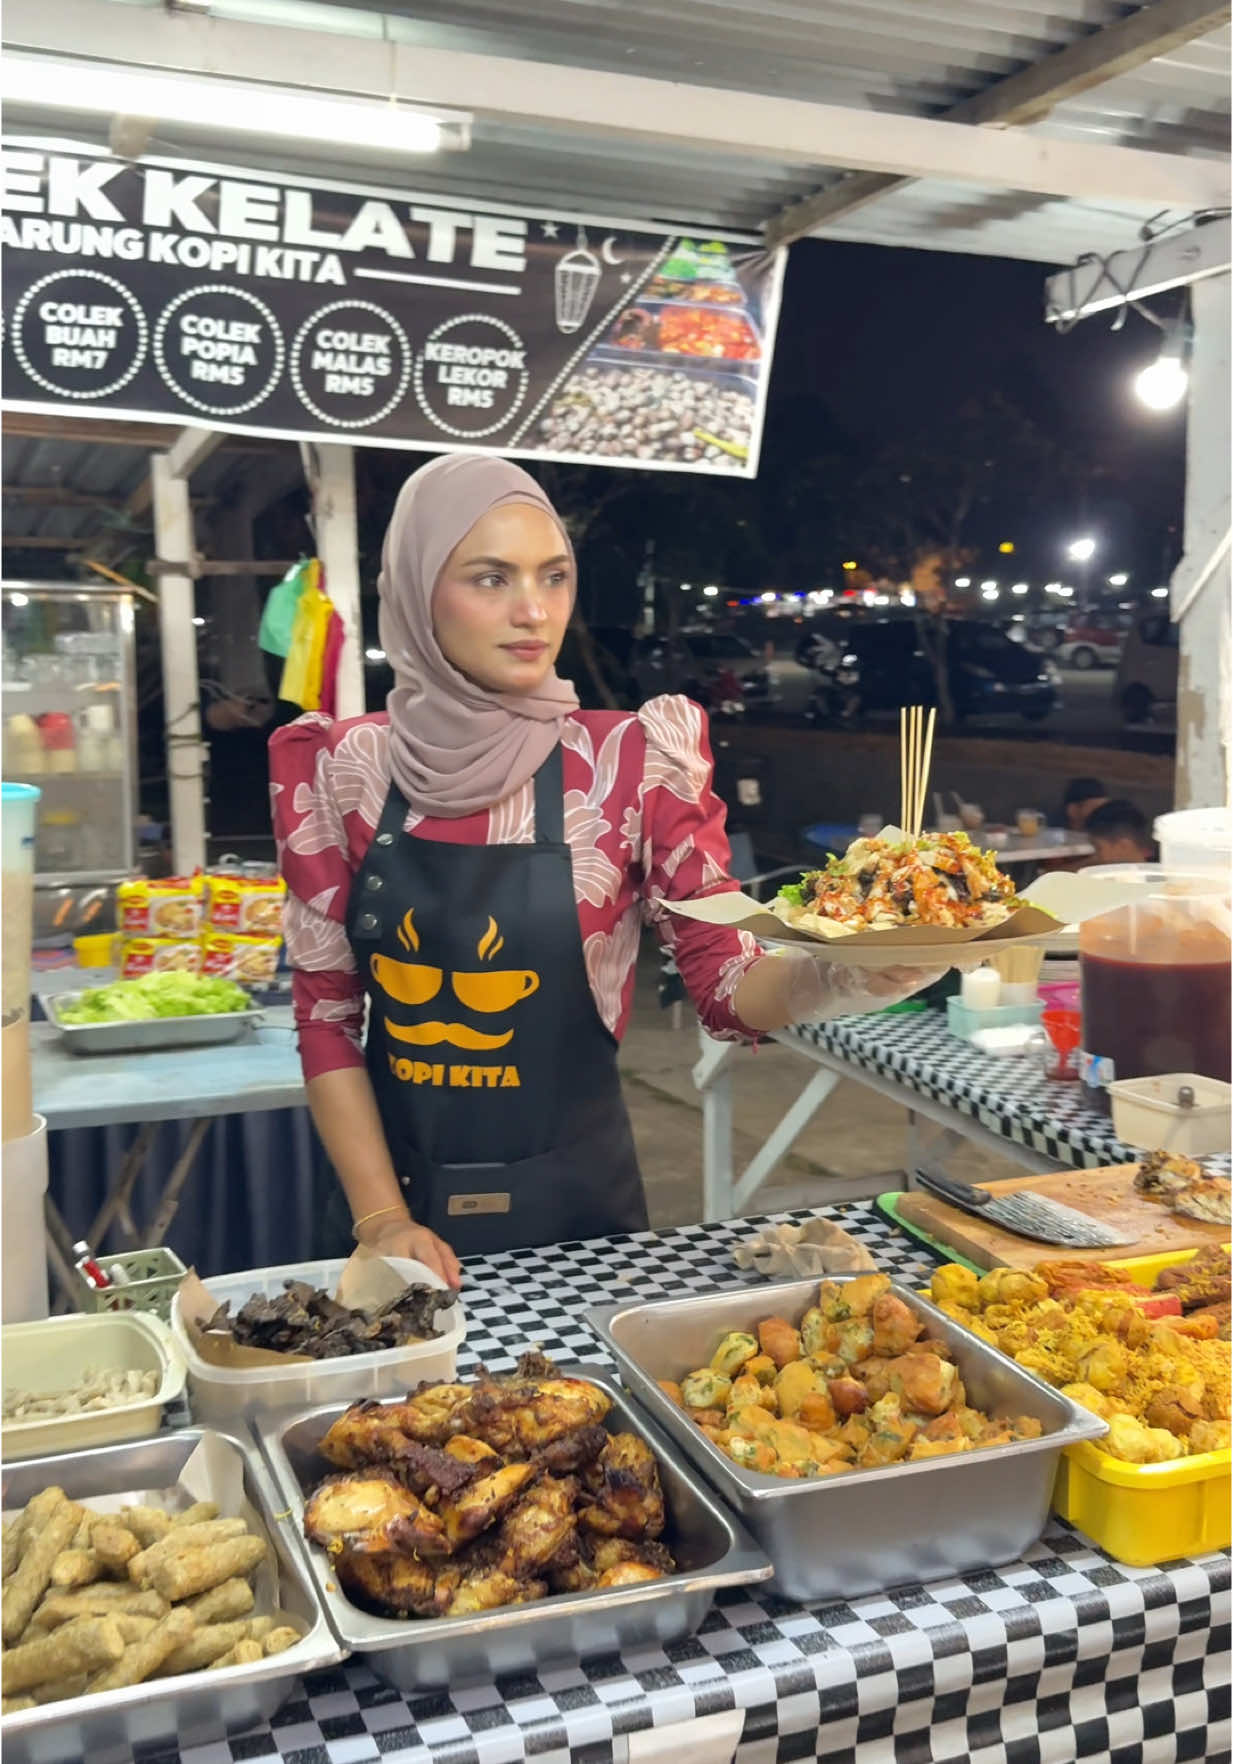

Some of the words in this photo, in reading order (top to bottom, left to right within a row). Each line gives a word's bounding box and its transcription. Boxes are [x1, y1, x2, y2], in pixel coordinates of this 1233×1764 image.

[143, 169, 527, 272] KELATE
[149, 232, 250, 275] KOPI
[255, 244, 346, 284] KITA
[39, 302, 124, 327] COLEK
[45, 325, 117, 348] BUAH
[180, 314, 262, 342] COLEK
[181, 336, 257, 366] POPIA
[316, 329, 392, 354] COLEK
[52, 348, 108, 369] RM7
[312, 351, 392, 377] MALAS
[425, 342, 527, 369] KEROPOK
[191, 359, 245, 386] RM5
[437, 364, 508, 389] LEKOR
[325, 374, 374, 397] RM5
[447, 386, 495, 409] RM5
[449, 1064, 521, 1088] KITA
